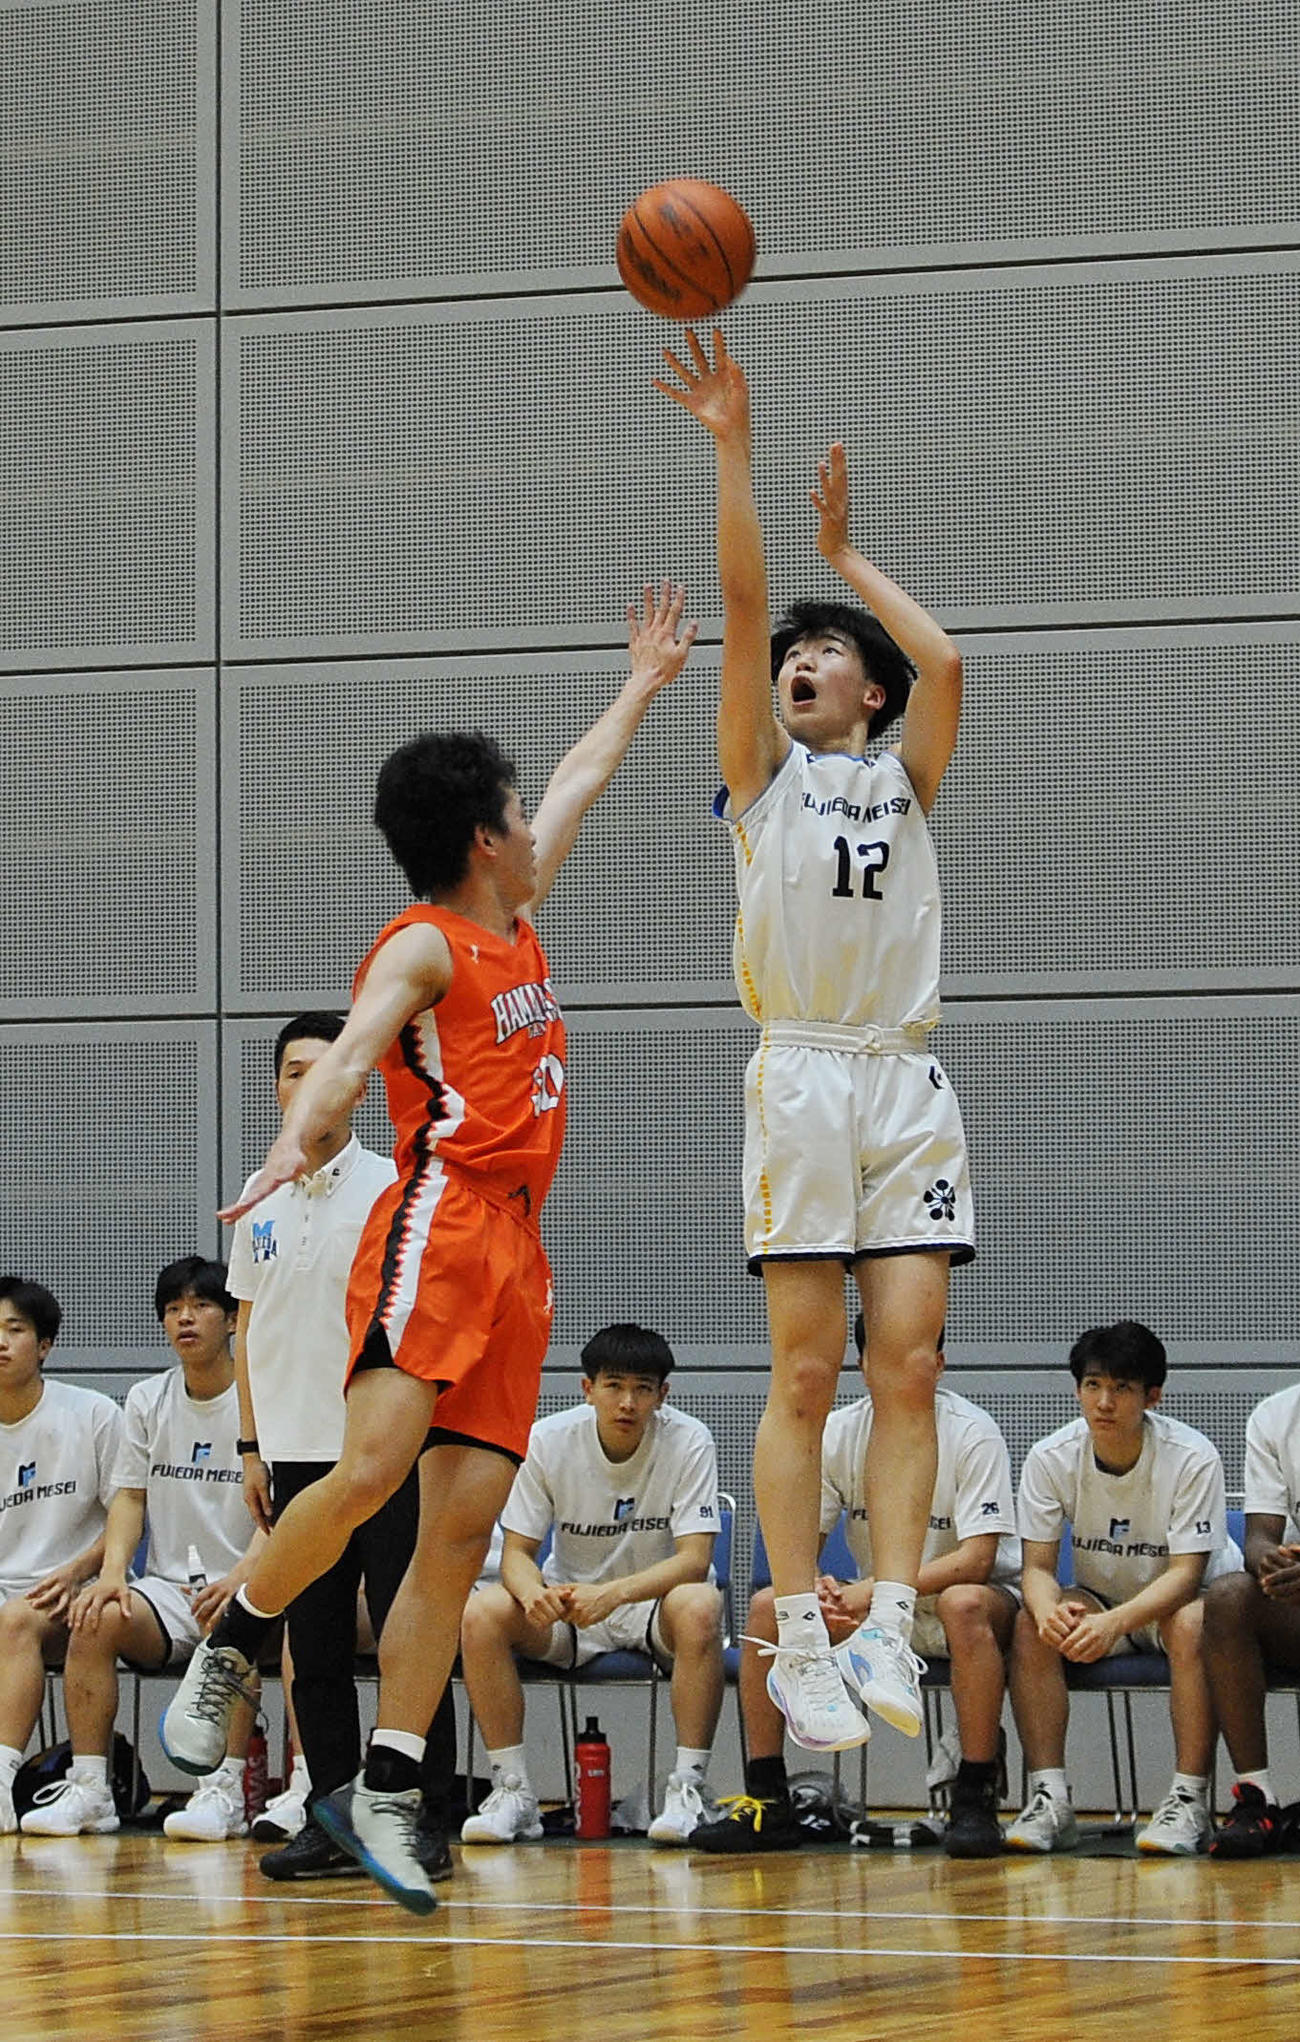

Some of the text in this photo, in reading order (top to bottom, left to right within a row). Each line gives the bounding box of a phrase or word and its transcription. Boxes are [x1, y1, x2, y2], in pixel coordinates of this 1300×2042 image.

[833, 836, 889, 900] 12
[699, 1506, 714, 1519] 91
[982, 1502, 1001, 1516] 26
[1196, 1520, 1212, 1535] 13
